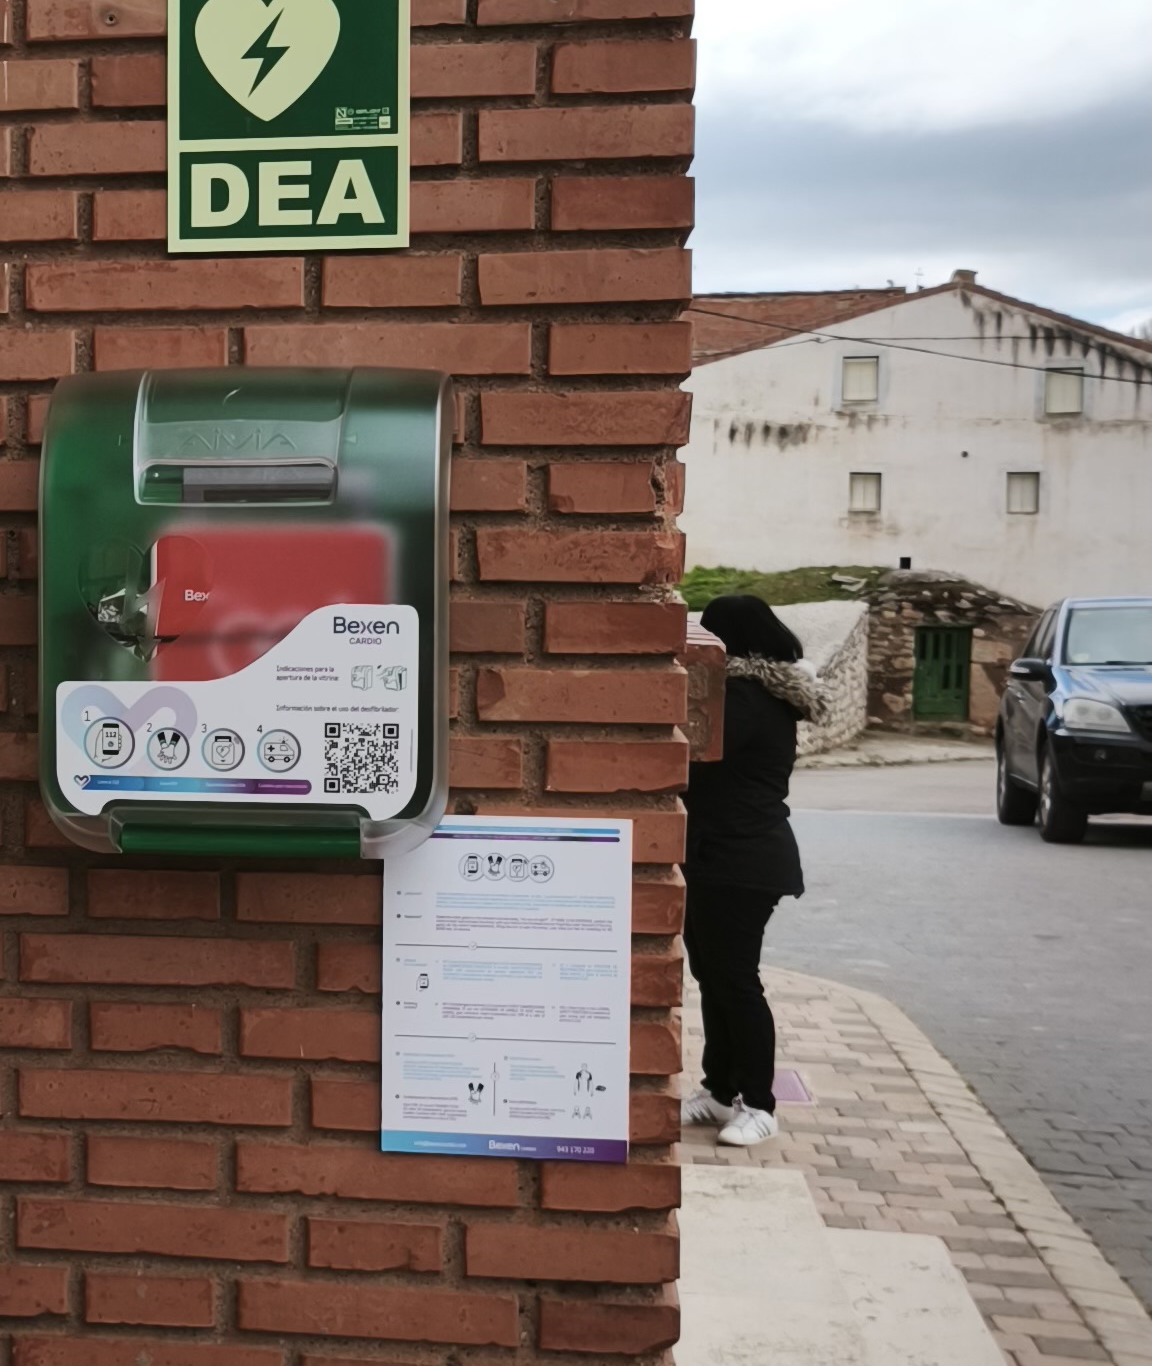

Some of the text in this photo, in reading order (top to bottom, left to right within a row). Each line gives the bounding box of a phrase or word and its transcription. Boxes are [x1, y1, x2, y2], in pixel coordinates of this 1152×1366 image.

[191, 159, 385, 227] DEA
[333, 616, 400, 634] Bexen
[349, 637, 382, 645] CARDIO
[84, 710, 91, 722] 1
[146, 722, 153, 733] 2
[201, 723, 207, 733] 3
[257, 724, 263, 734] 4
